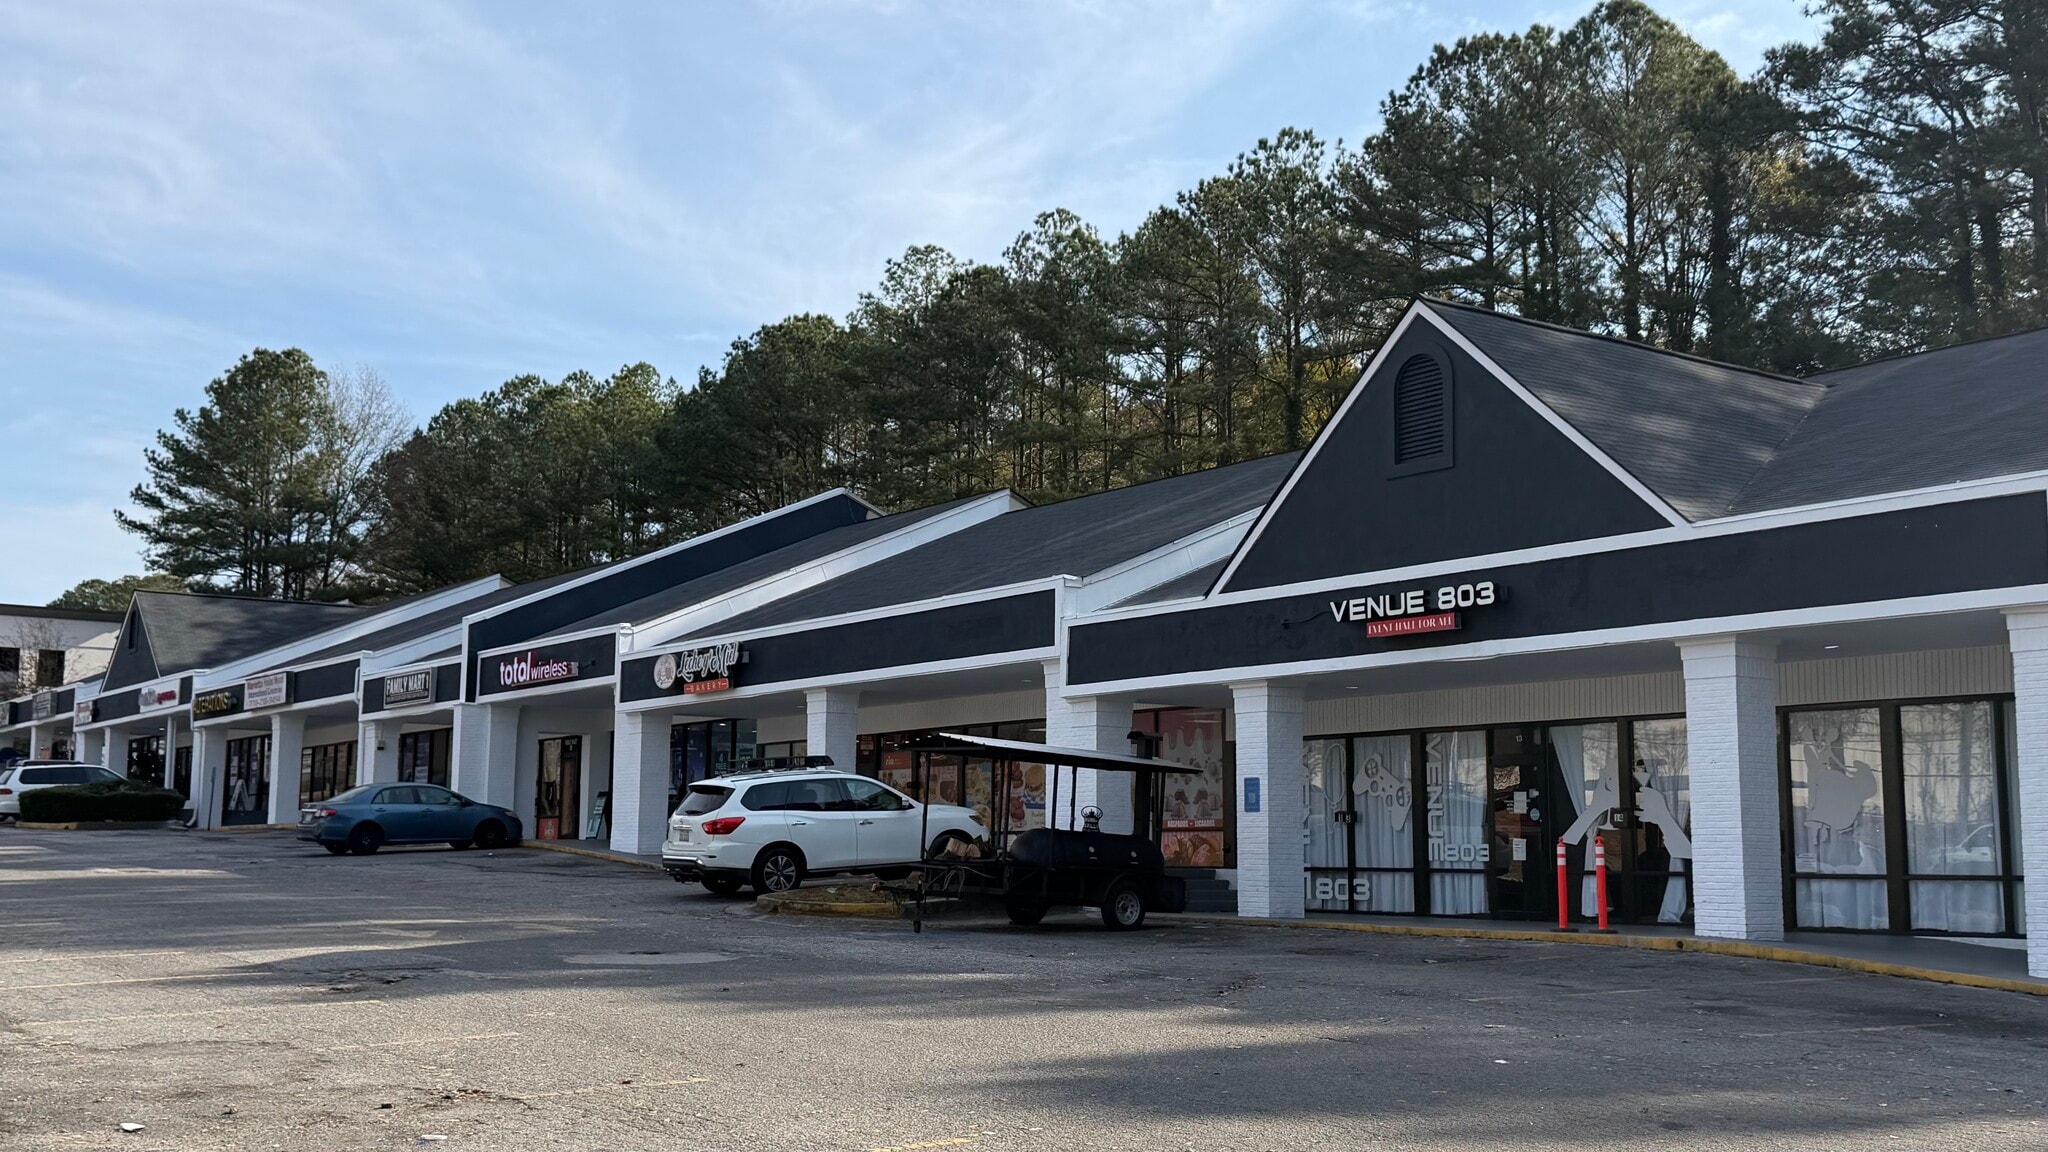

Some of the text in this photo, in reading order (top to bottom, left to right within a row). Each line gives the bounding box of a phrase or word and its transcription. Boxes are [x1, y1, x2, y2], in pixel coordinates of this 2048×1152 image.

[1329, 581, 1495, 622] VENUE 803
[1368, 621, 1393, 635] EVENT
[1394, 619, 1415, 632] HALL
[1418, 617, 1437, 630] FOR
[499, 651, 568, 686] total wireless
[386, 677, 408, 696] FAMILY
[408, 673, 426, 691] MART
[689, 681, 723, 693] BAKERY
[1426, 732, 1445, 862] VENUE
[1445, 844, 1490, 862] 803
[1315, 878, 1370, 901] 803
